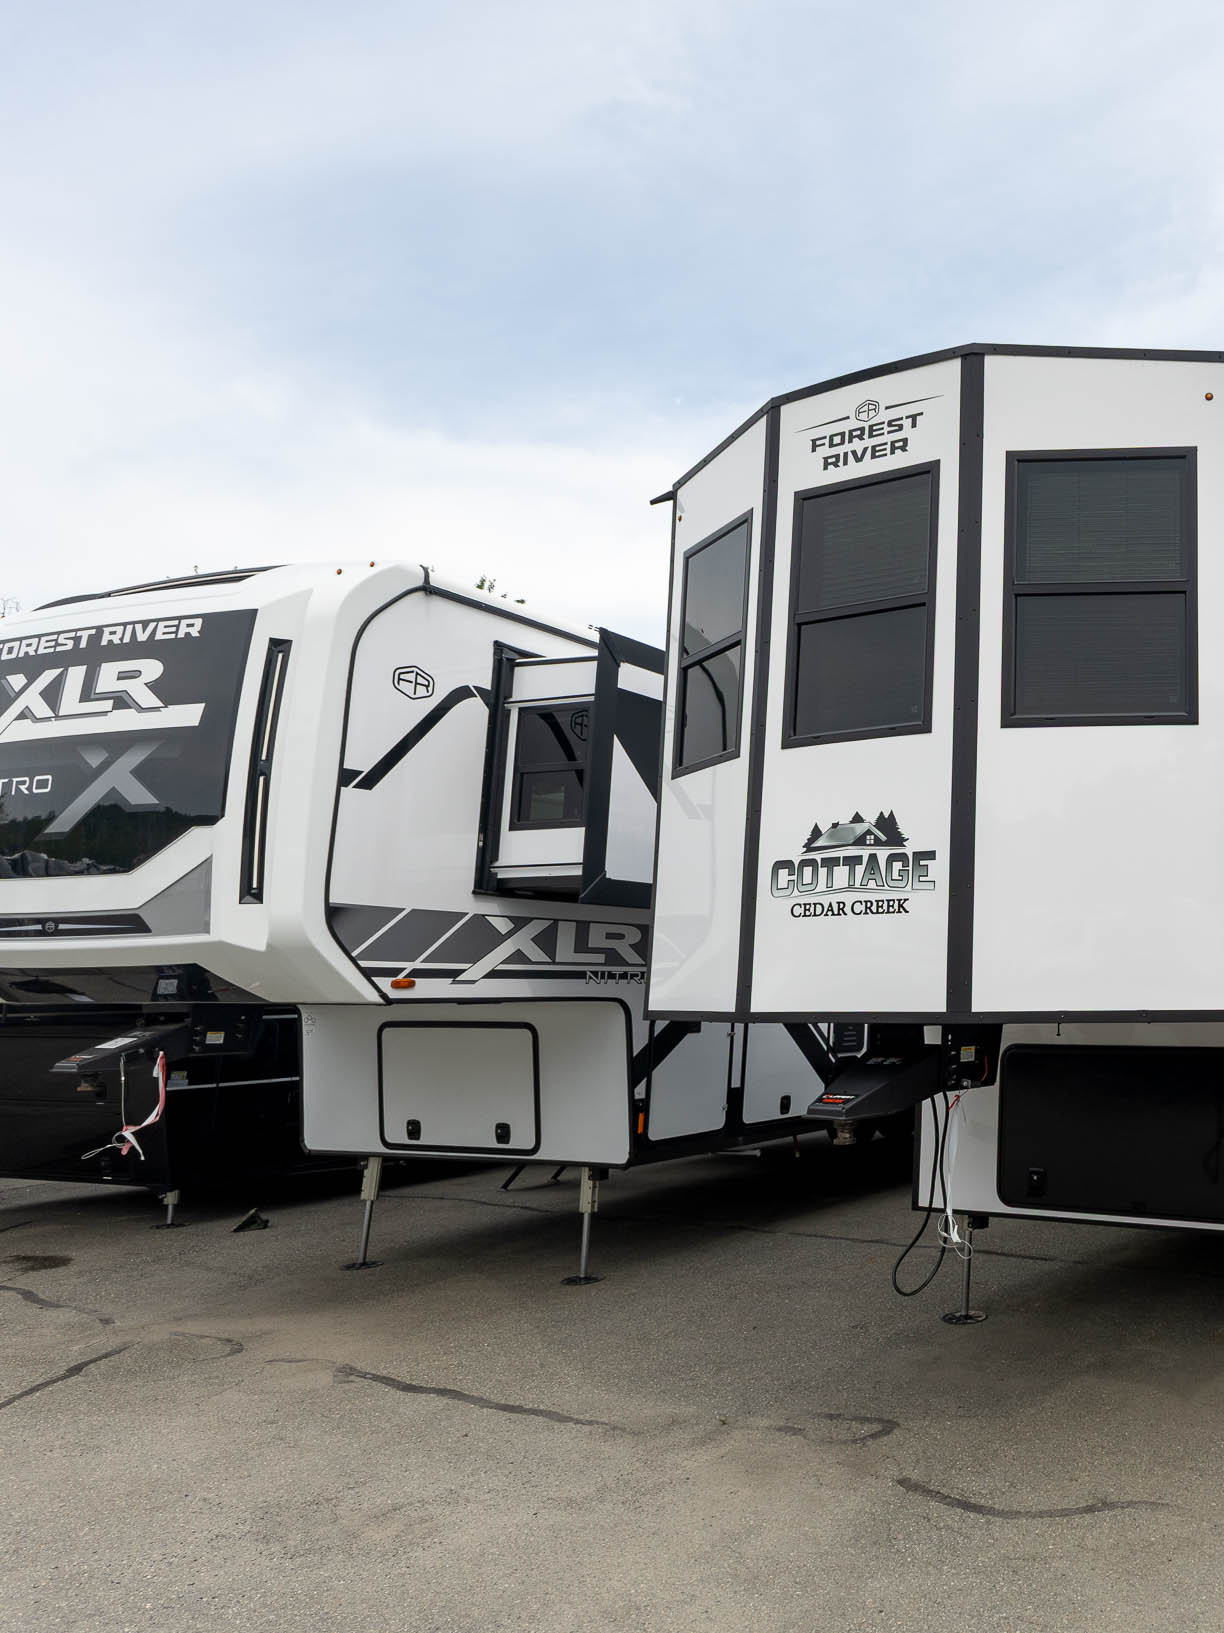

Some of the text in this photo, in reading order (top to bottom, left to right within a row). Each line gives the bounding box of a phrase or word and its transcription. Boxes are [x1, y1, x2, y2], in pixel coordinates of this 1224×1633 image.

[811, 412, 923, 453] FOREST
[823, 438, 908, 471] RIVER
[0, 618, 203, 660] OREST RIVER
[0, 659, 168, 734] XLR
[771, 850, 936, 898] COTTAGE
[791, 899, 909, 918] CEDAR CREEK
[454, 915, 646, 981] XLR
[586, 971, 648, 984] NITR
